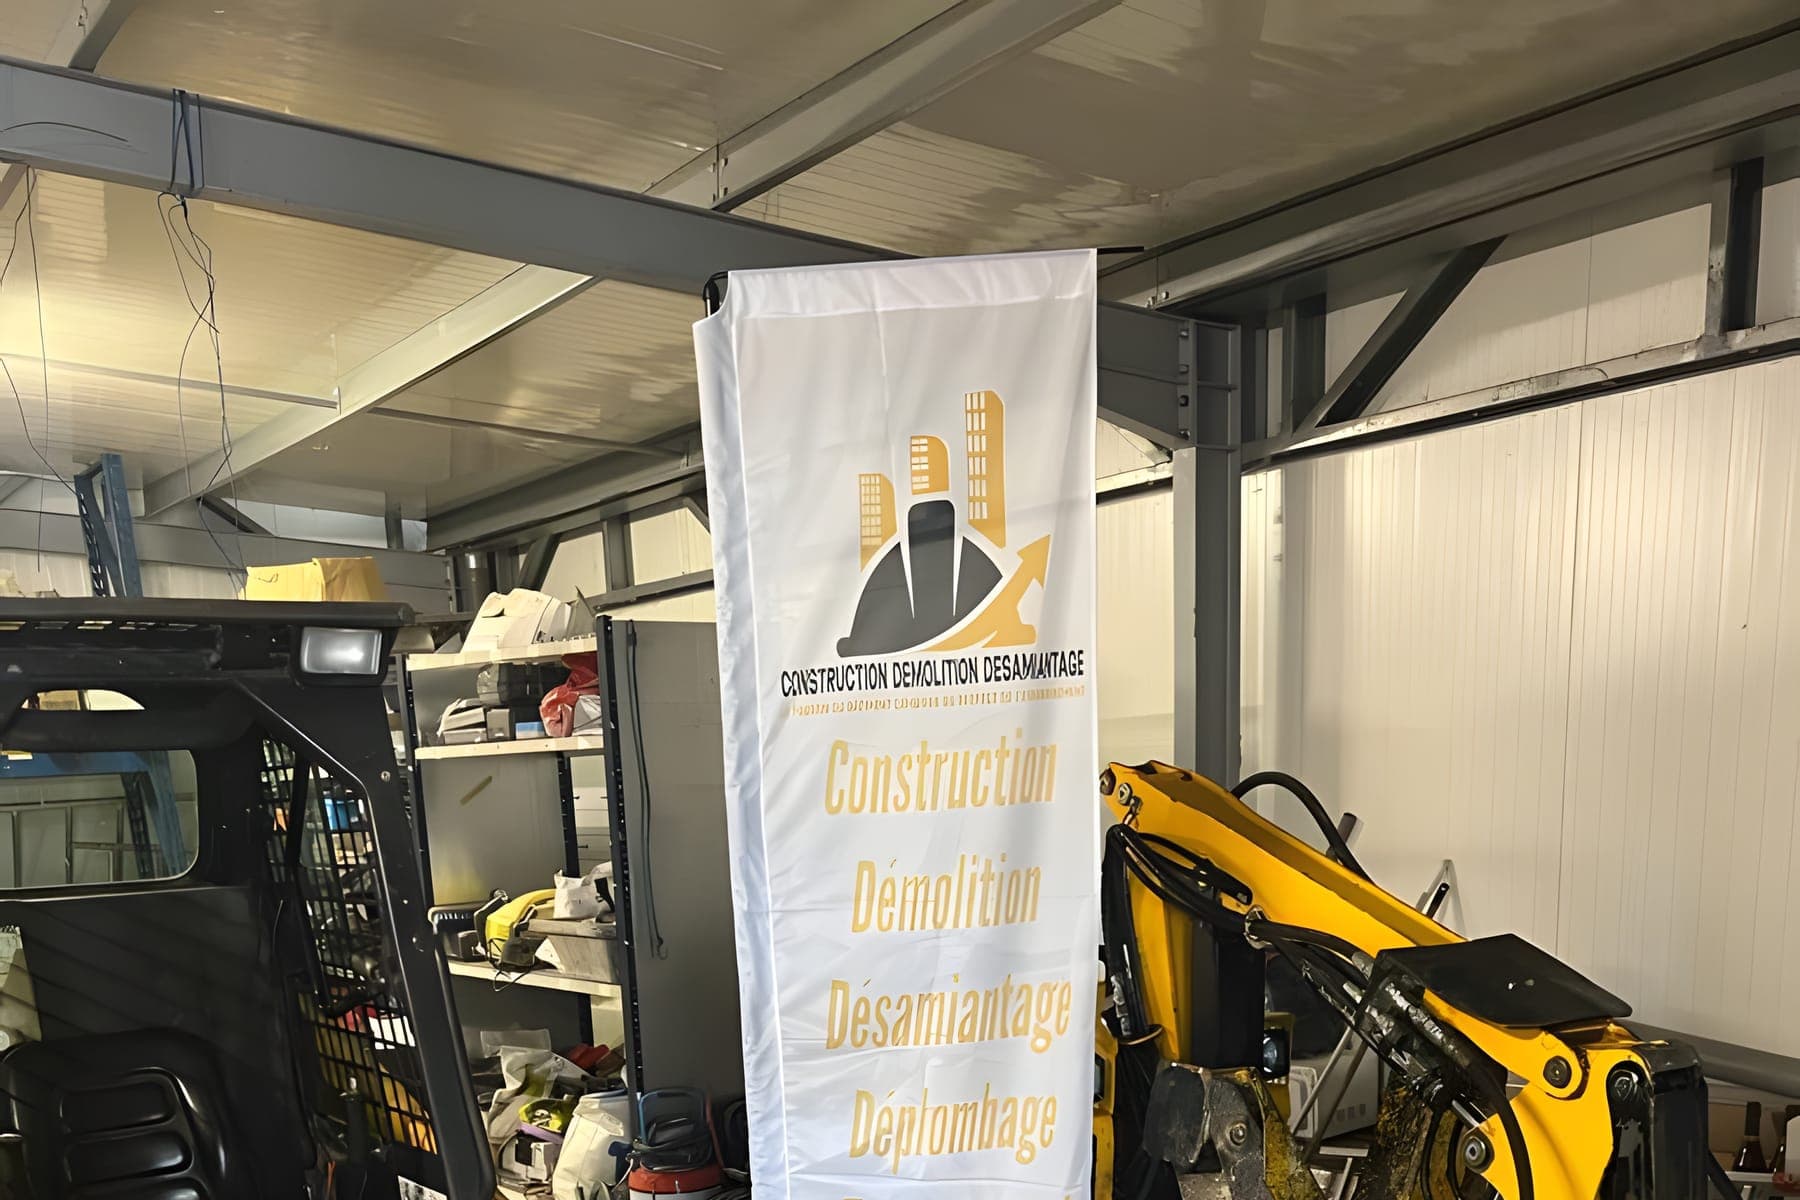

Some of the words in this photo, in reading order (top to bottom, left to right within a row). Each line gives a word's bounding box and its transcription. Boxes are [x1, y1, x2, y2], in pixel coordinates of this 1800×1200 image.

[781, 662, 888, 697] CONSTRUCTION
[892, 657, 979, 689] DEMOLITION
[824, 727, 1057, 815] Construction
[851, 852, 1041, 934] Démolition
[826, 972, 1072, 1054] Désamiantage
